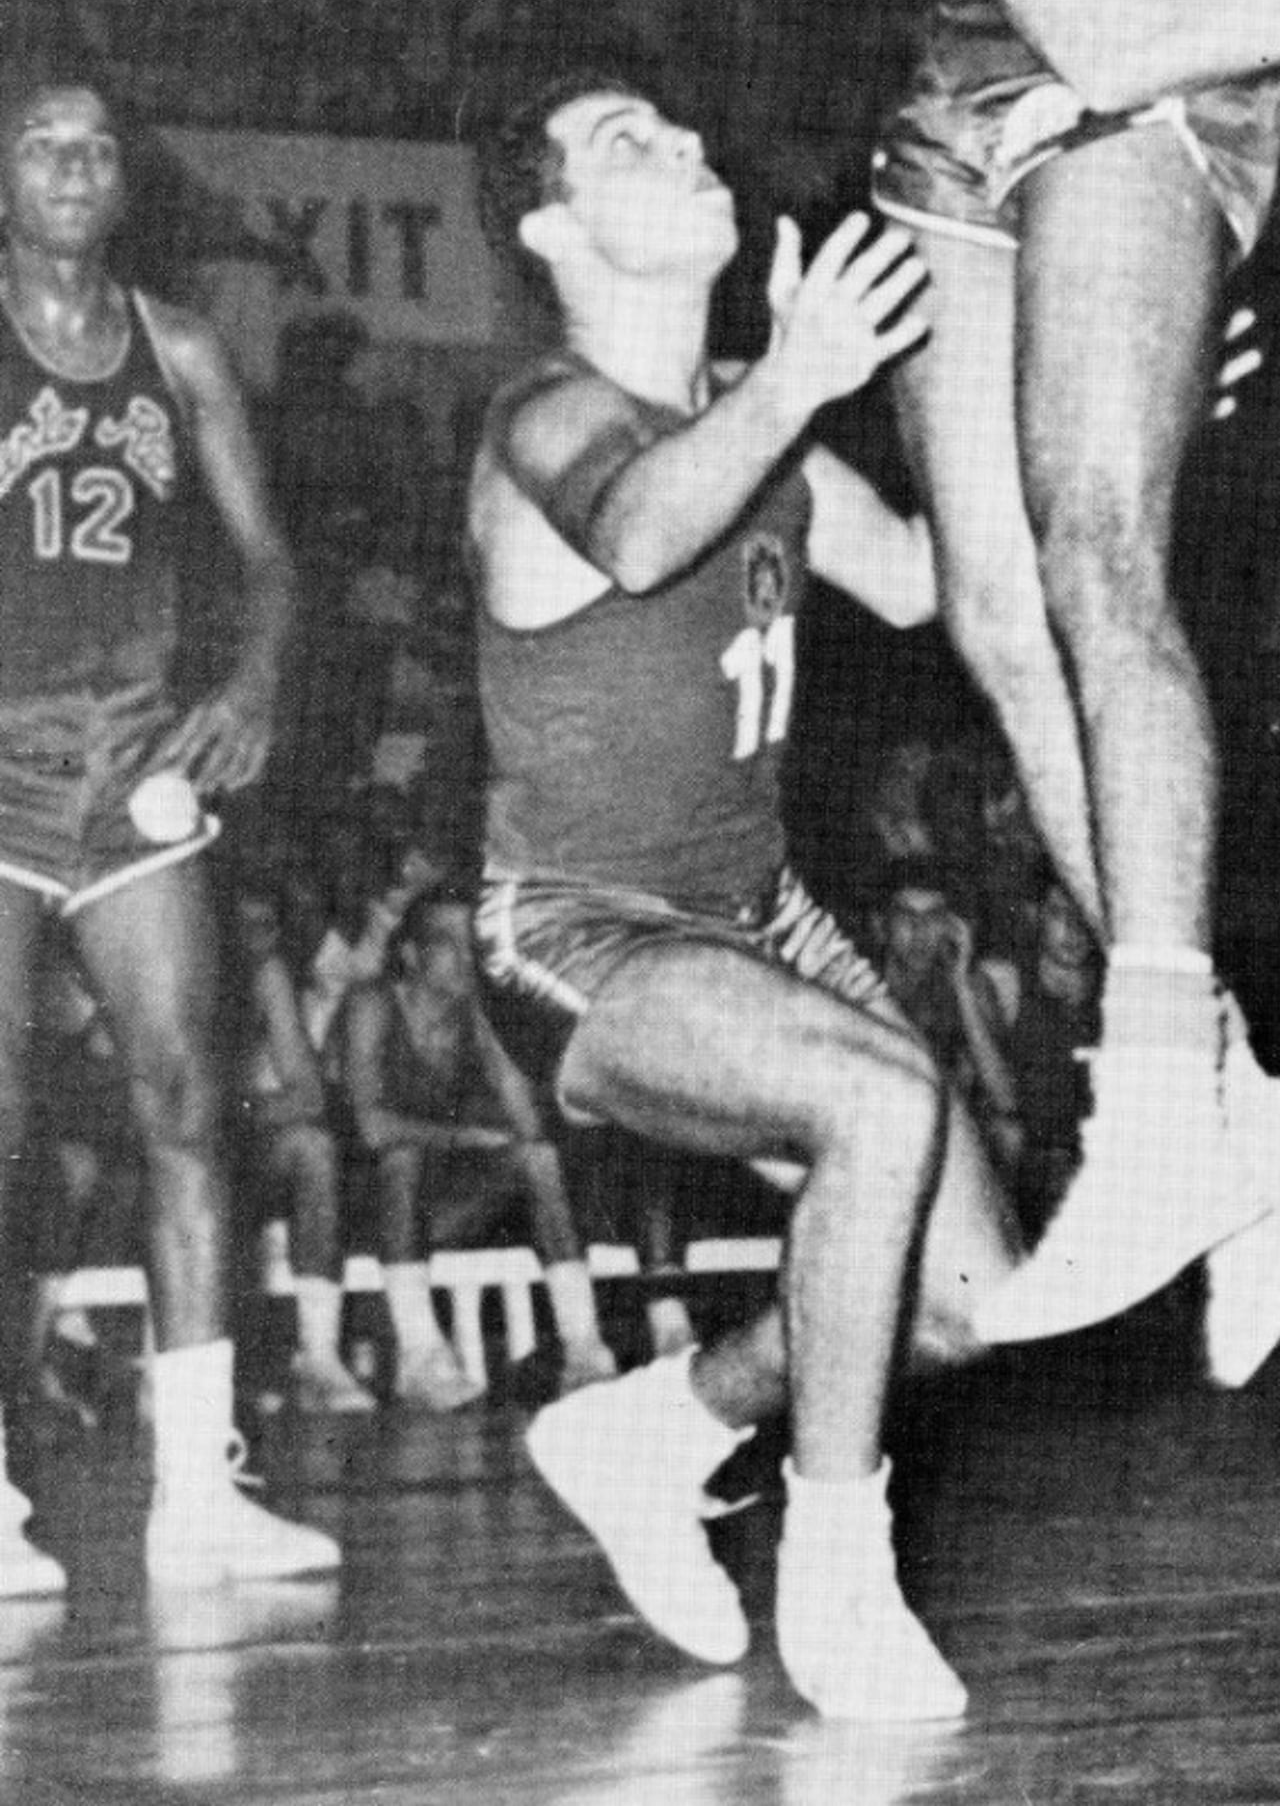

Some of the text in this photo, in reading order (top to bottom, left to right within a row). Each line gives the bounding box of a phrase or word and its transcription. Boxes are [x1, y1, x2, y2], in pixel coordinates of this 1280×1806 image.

[255, 192, 442, 301] XIT
[29, 465, 135, 563] 12
[718, 613, 796, 762] 11
